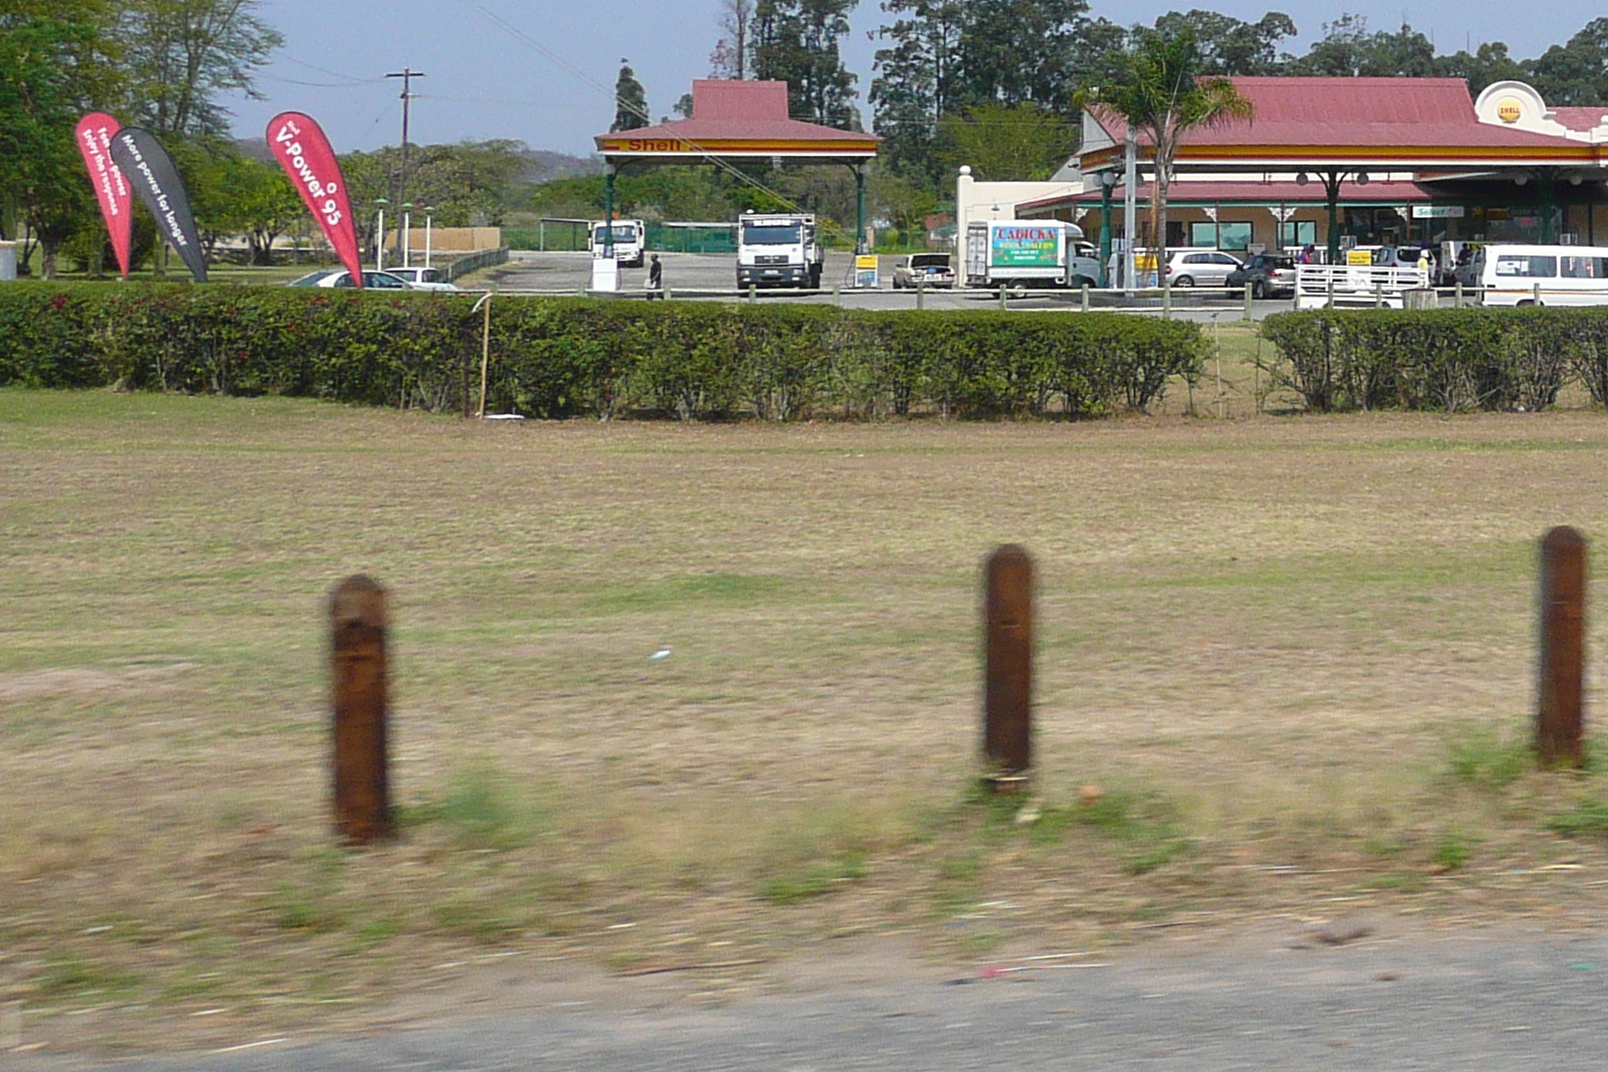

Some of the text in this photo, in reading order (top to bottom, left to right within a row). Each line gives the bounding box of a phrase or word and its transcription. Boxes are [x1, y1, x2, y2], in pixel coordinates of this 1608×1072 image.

[83, 128, 99, 154] Enjoy
[94, 154, 105, 171] the
[101, 172, 118, 215] response
[110, 165, 126, 196] power
[276, 126, 343, 226] V-Power 95
[628, 138, 681, 152] Shell
[122, 134, 188, 247] More power for longer
